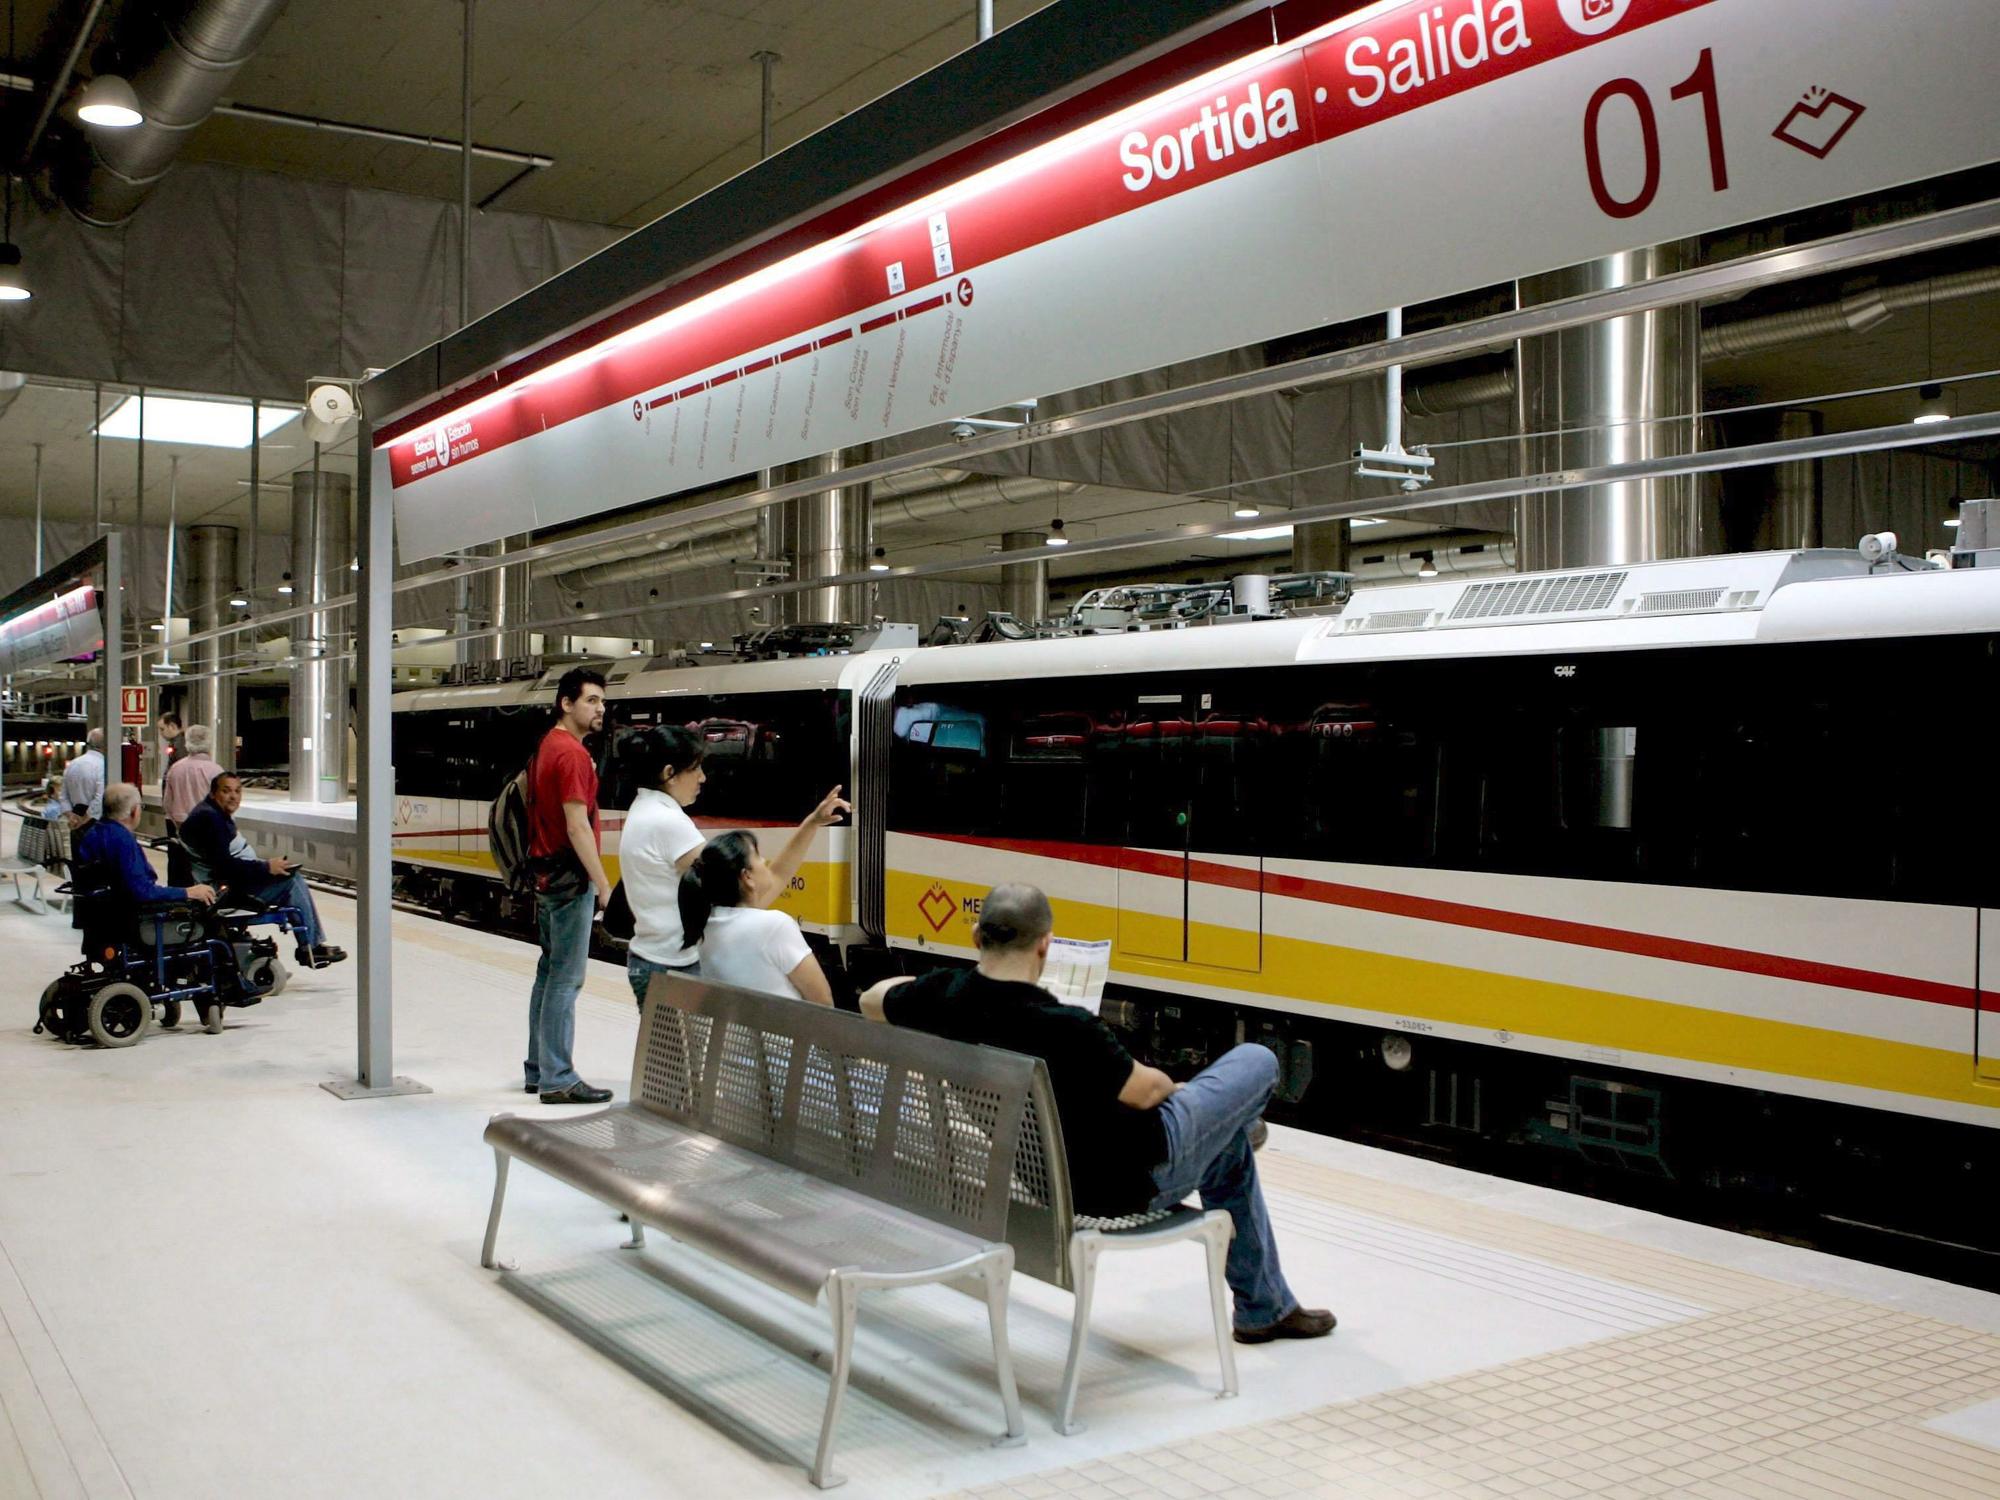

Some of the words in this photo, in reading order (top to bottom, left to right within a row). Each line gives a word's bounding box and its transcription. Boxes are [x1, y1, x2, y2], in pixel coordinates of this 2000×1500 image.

[1119, 83, 1300, 192] Sortida
[1344, 0, 1532, 108] Salida
[1582, 47, 1729, 219] 01
[1554, 665, 1576, 677] CAF
